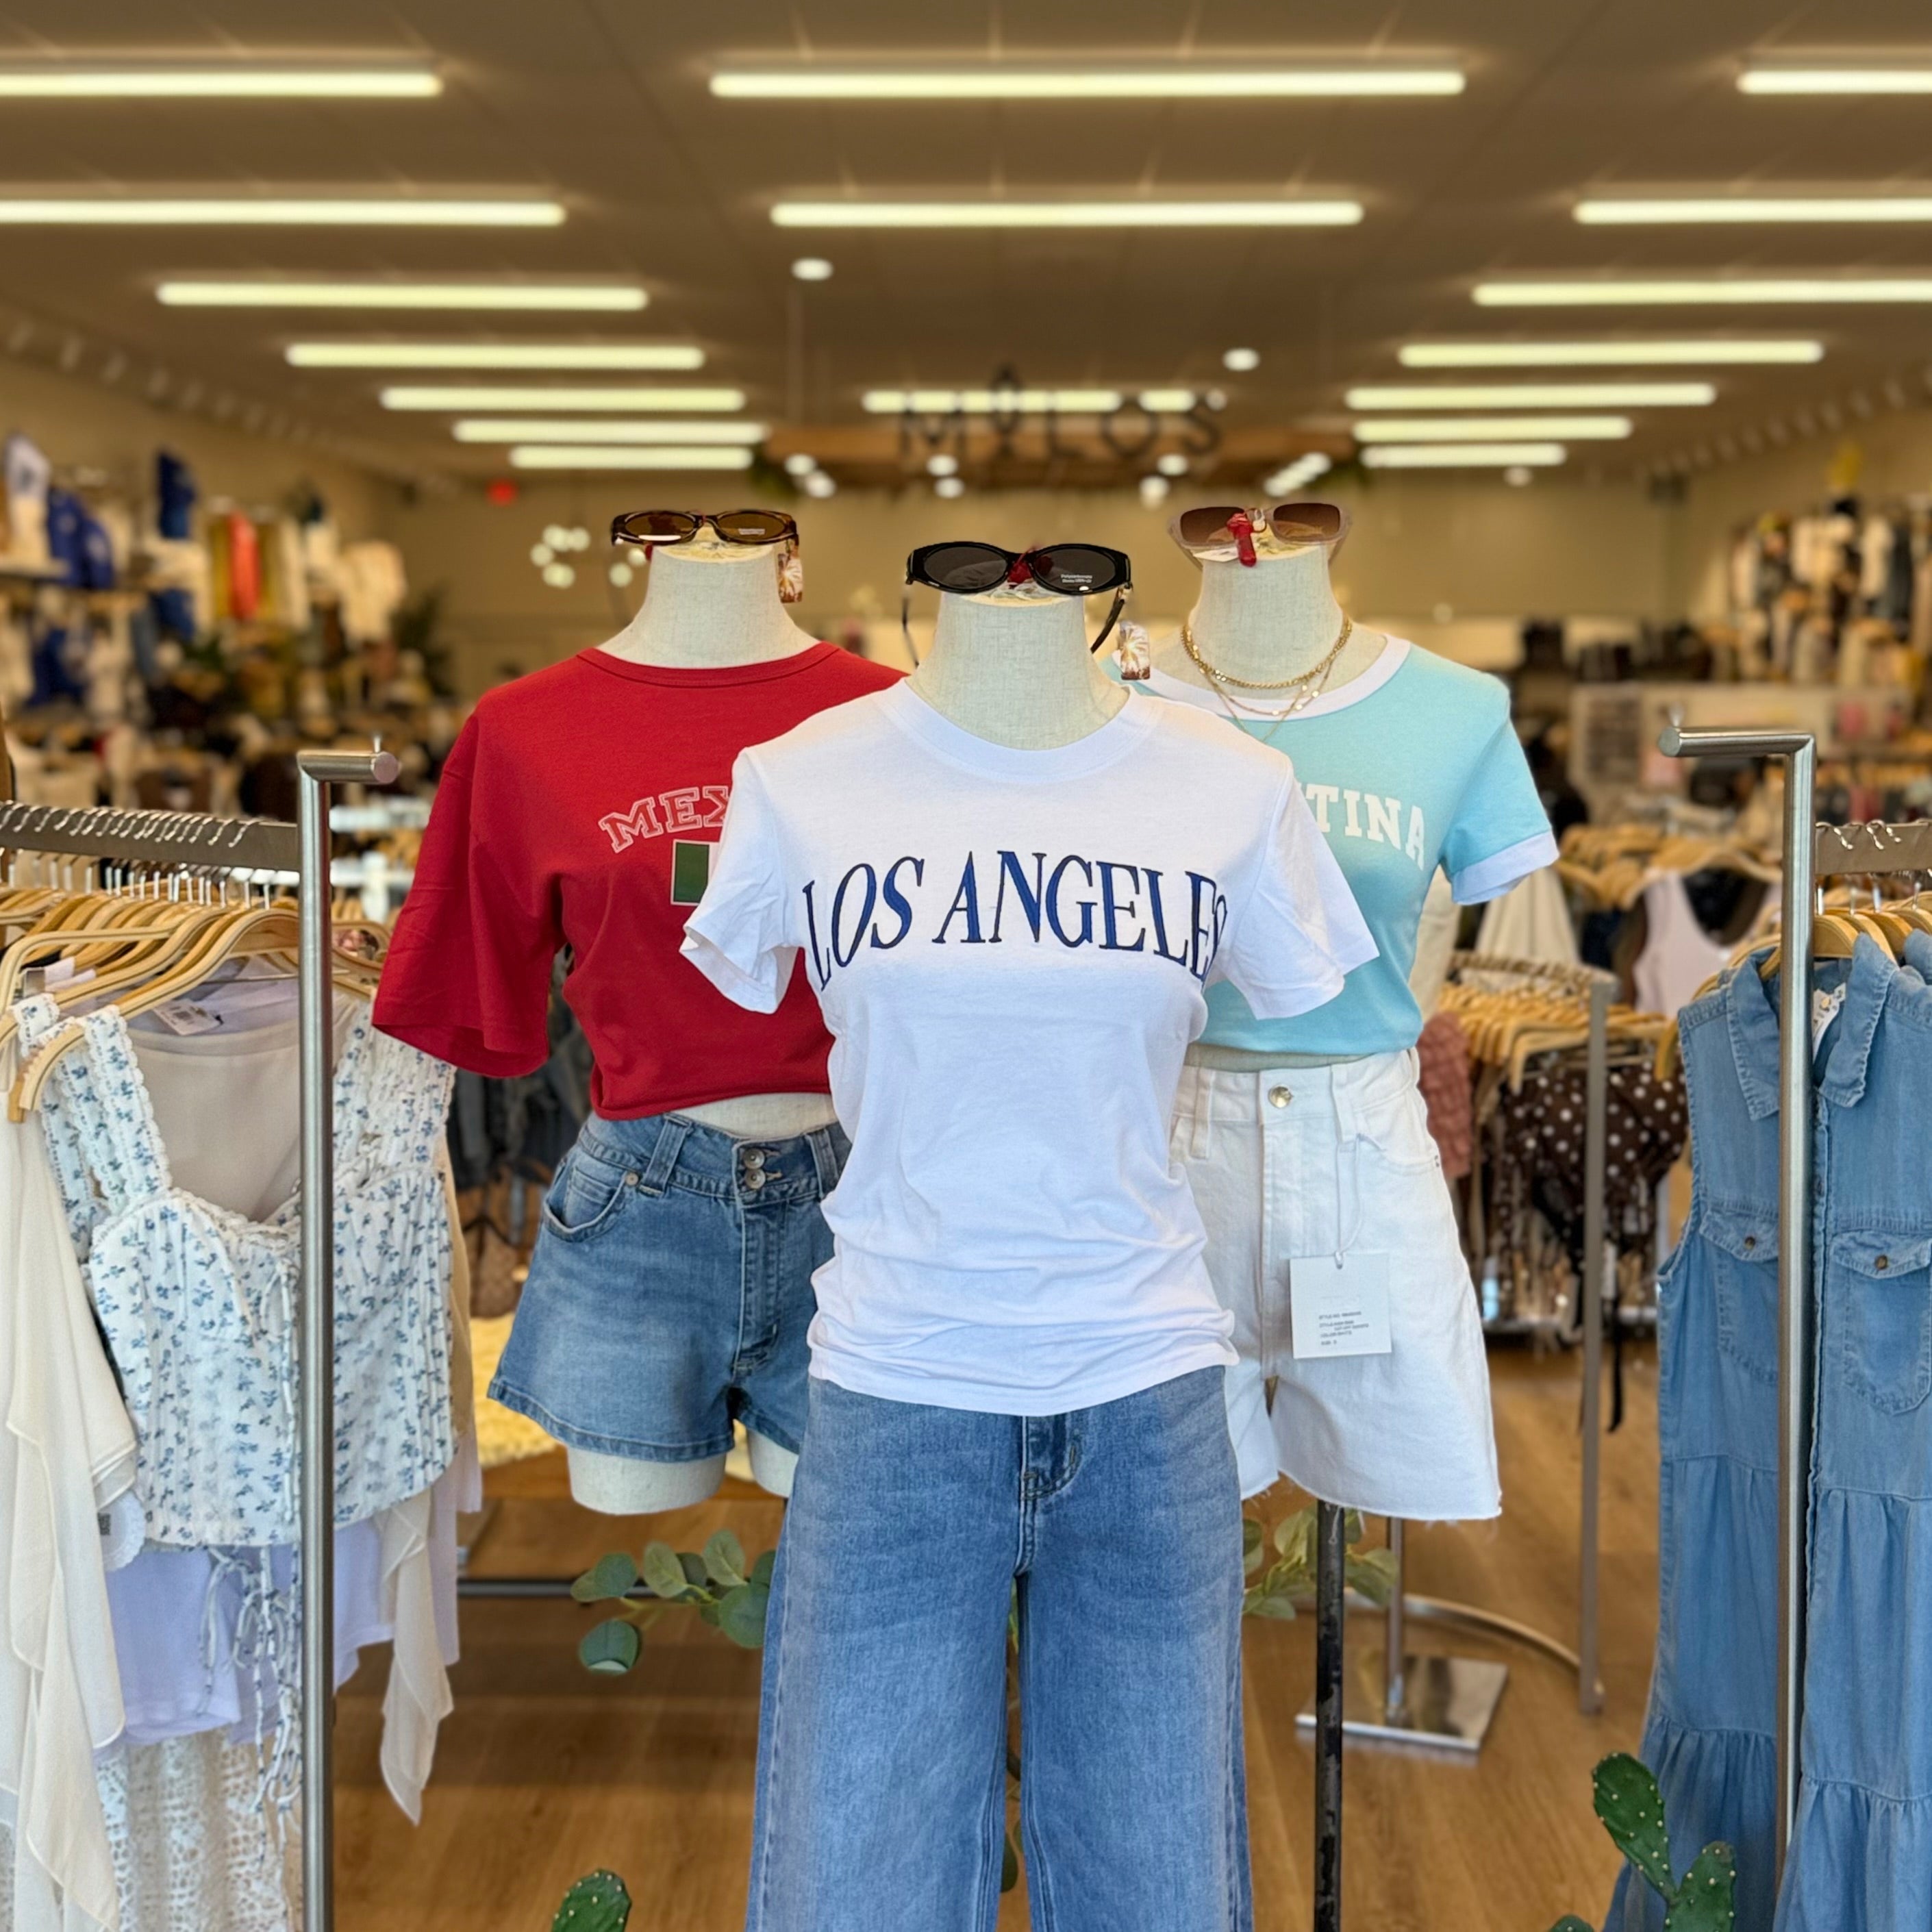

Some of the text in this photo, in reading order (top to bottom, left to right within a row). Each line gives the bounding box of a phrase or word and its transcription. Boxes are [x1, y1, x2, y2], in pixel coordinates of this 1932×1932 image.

[598, 786, 730, 853] MEX
[1305, 783, 1425, 871] TINA
[802, 856, 925, 991] LOS
